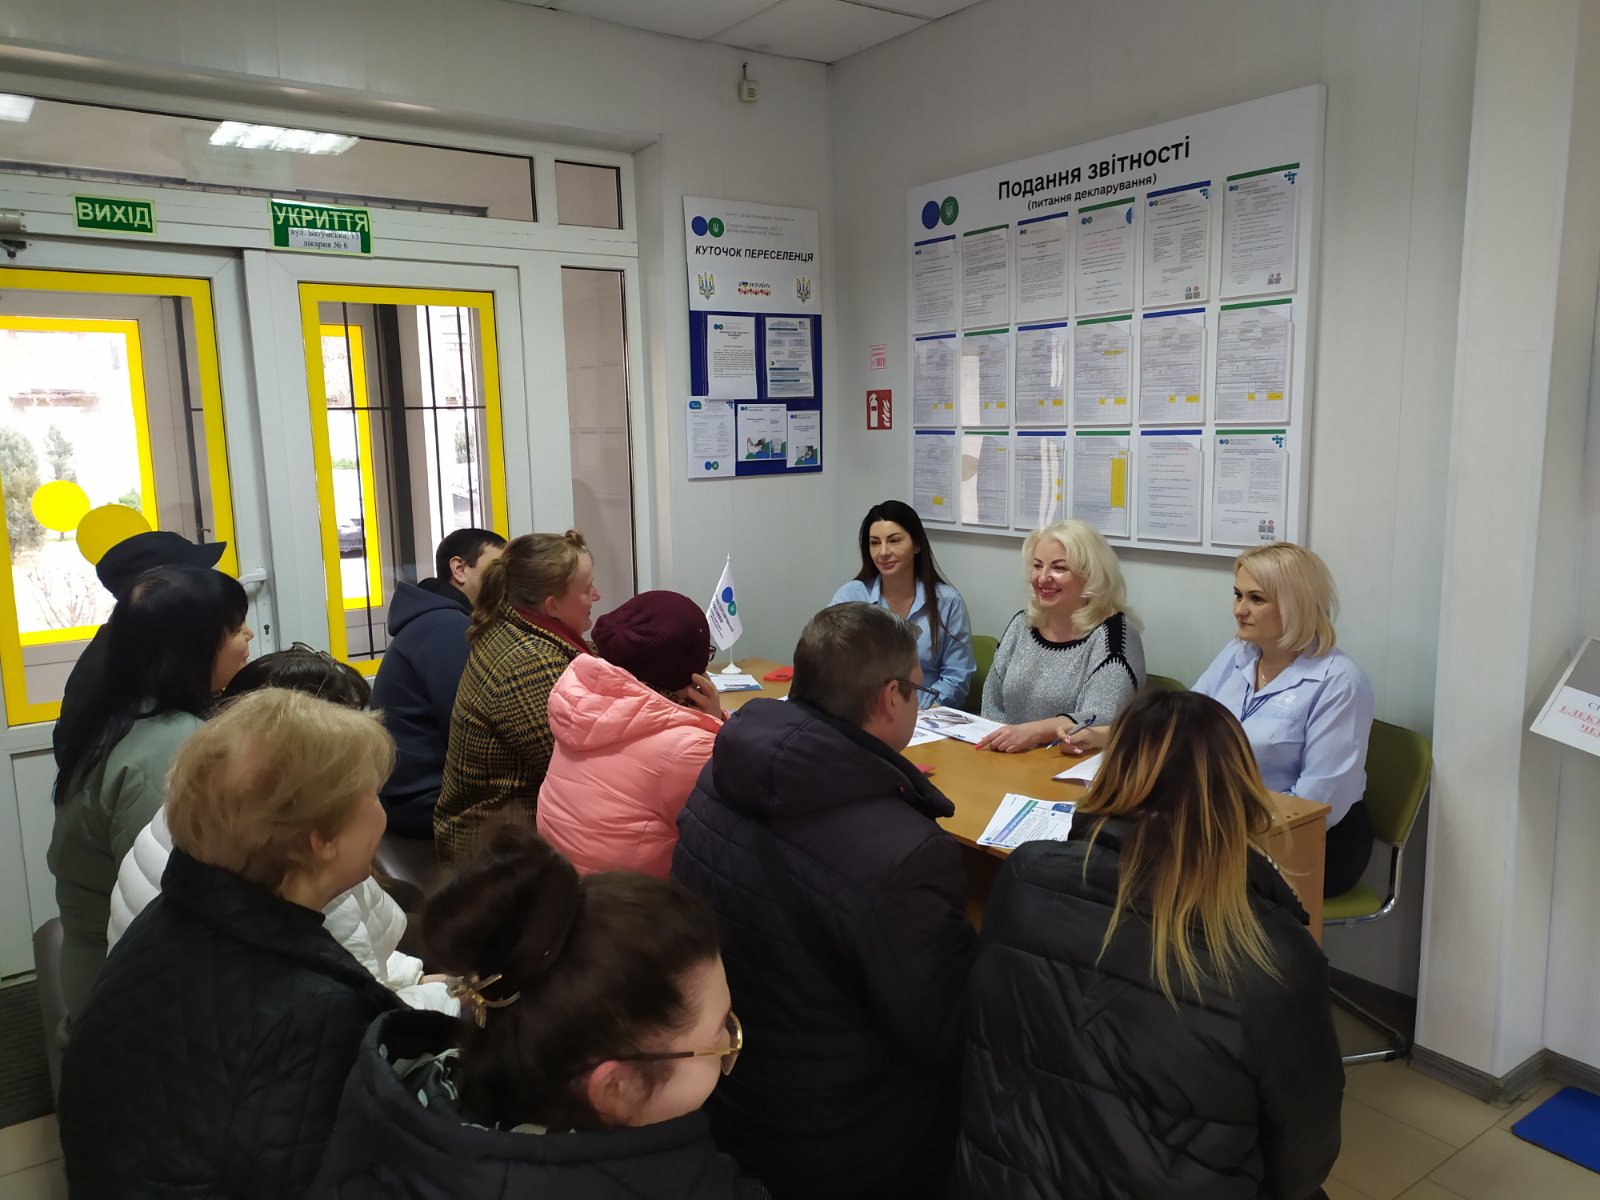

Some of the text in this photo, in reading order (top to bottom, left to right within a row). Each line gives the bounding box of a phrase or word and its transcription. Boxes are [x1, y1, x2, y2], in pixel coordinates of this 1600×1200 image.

[998, 136, 1190, 200] Подання звітності
[1027, 173, 1157, 211] (питання декларування)
[78, 202, 151, 229] ВИХІД
[273, 205, 369, 232] УКРИТТЯ
[290, 229, 306, 238] вул.
[303, 241, 331, 249] лікарня
[344, 241, 348, 249] 6
[695, 245, 814, 263] КУТОЧОК ПЕРЕСЕЛЕНЦЯ
